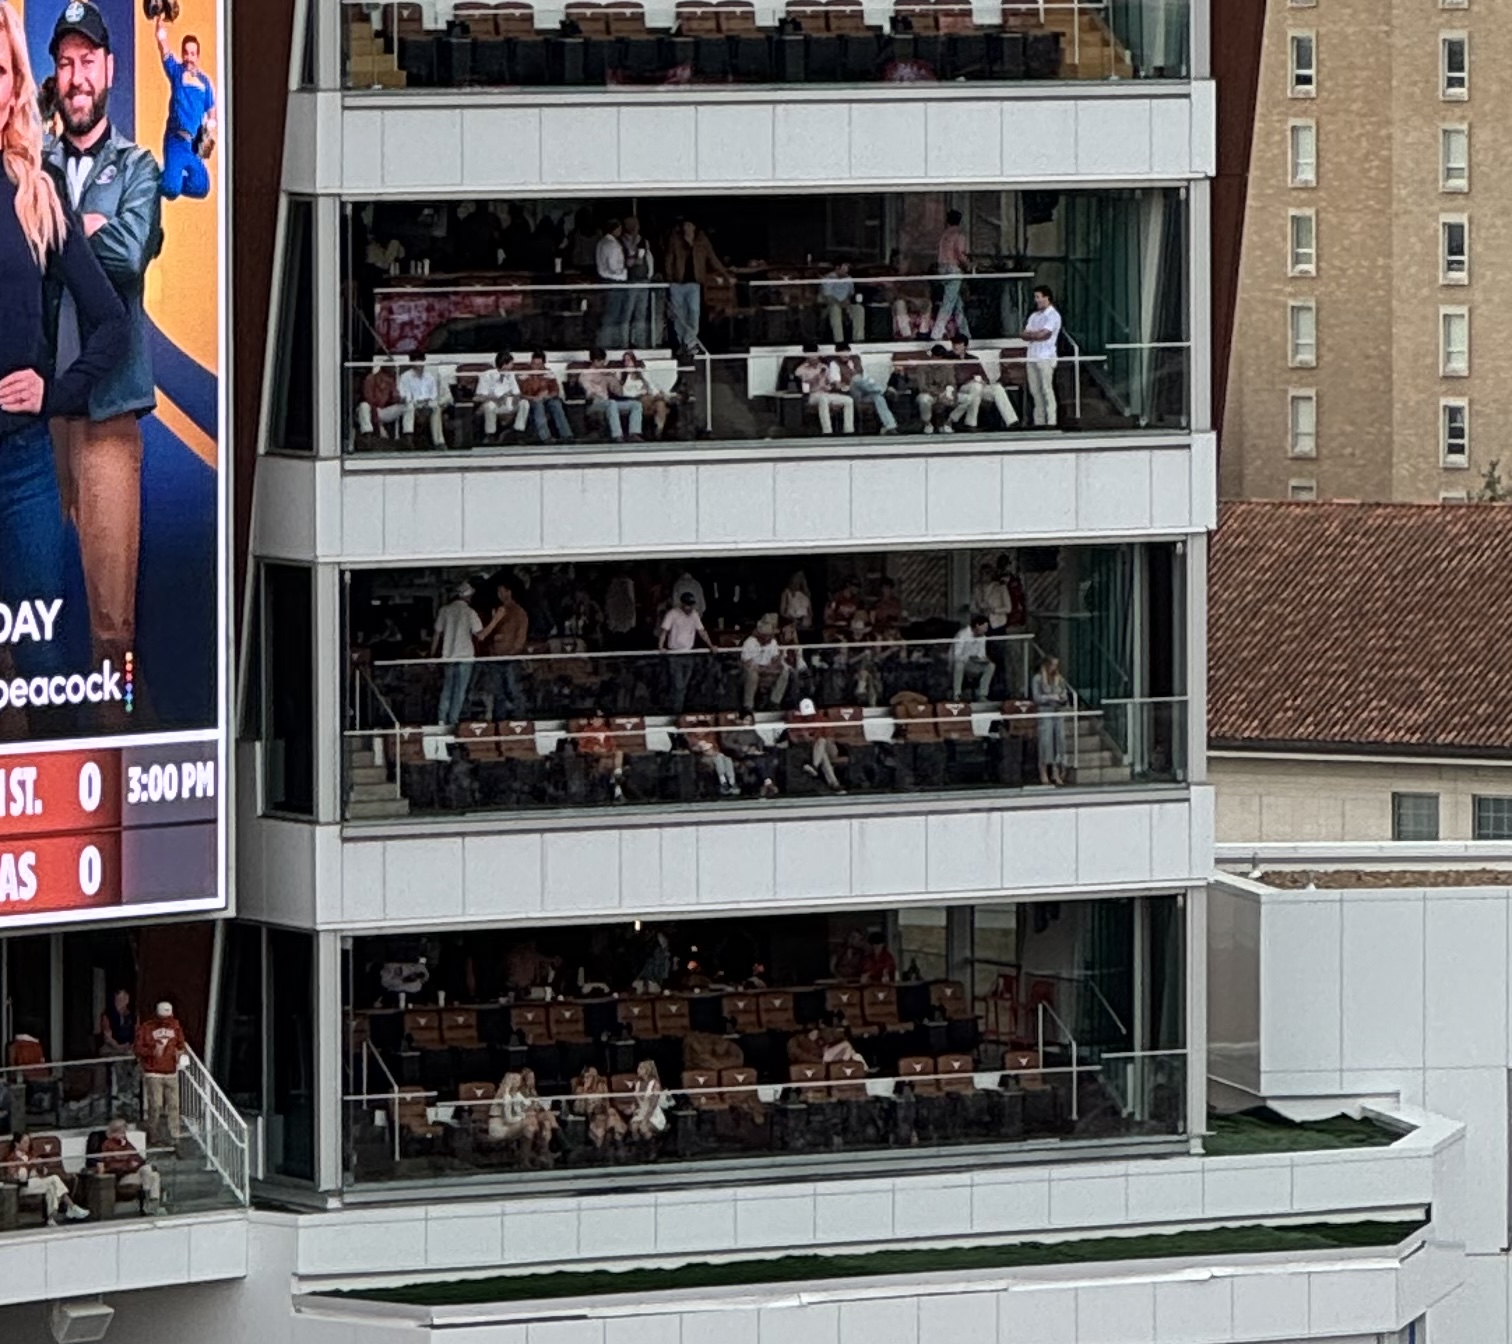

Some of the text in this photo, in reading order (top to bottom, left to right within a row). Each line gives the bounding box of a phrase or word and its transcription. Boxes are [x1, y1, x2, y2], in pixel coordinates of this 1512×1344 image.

[9, 766, 43, 816] ST.
[78, 761, 102, 812] 0
[127, 760, 216, 804] 3:00 PM
[78, 845, 102, 896] 0
